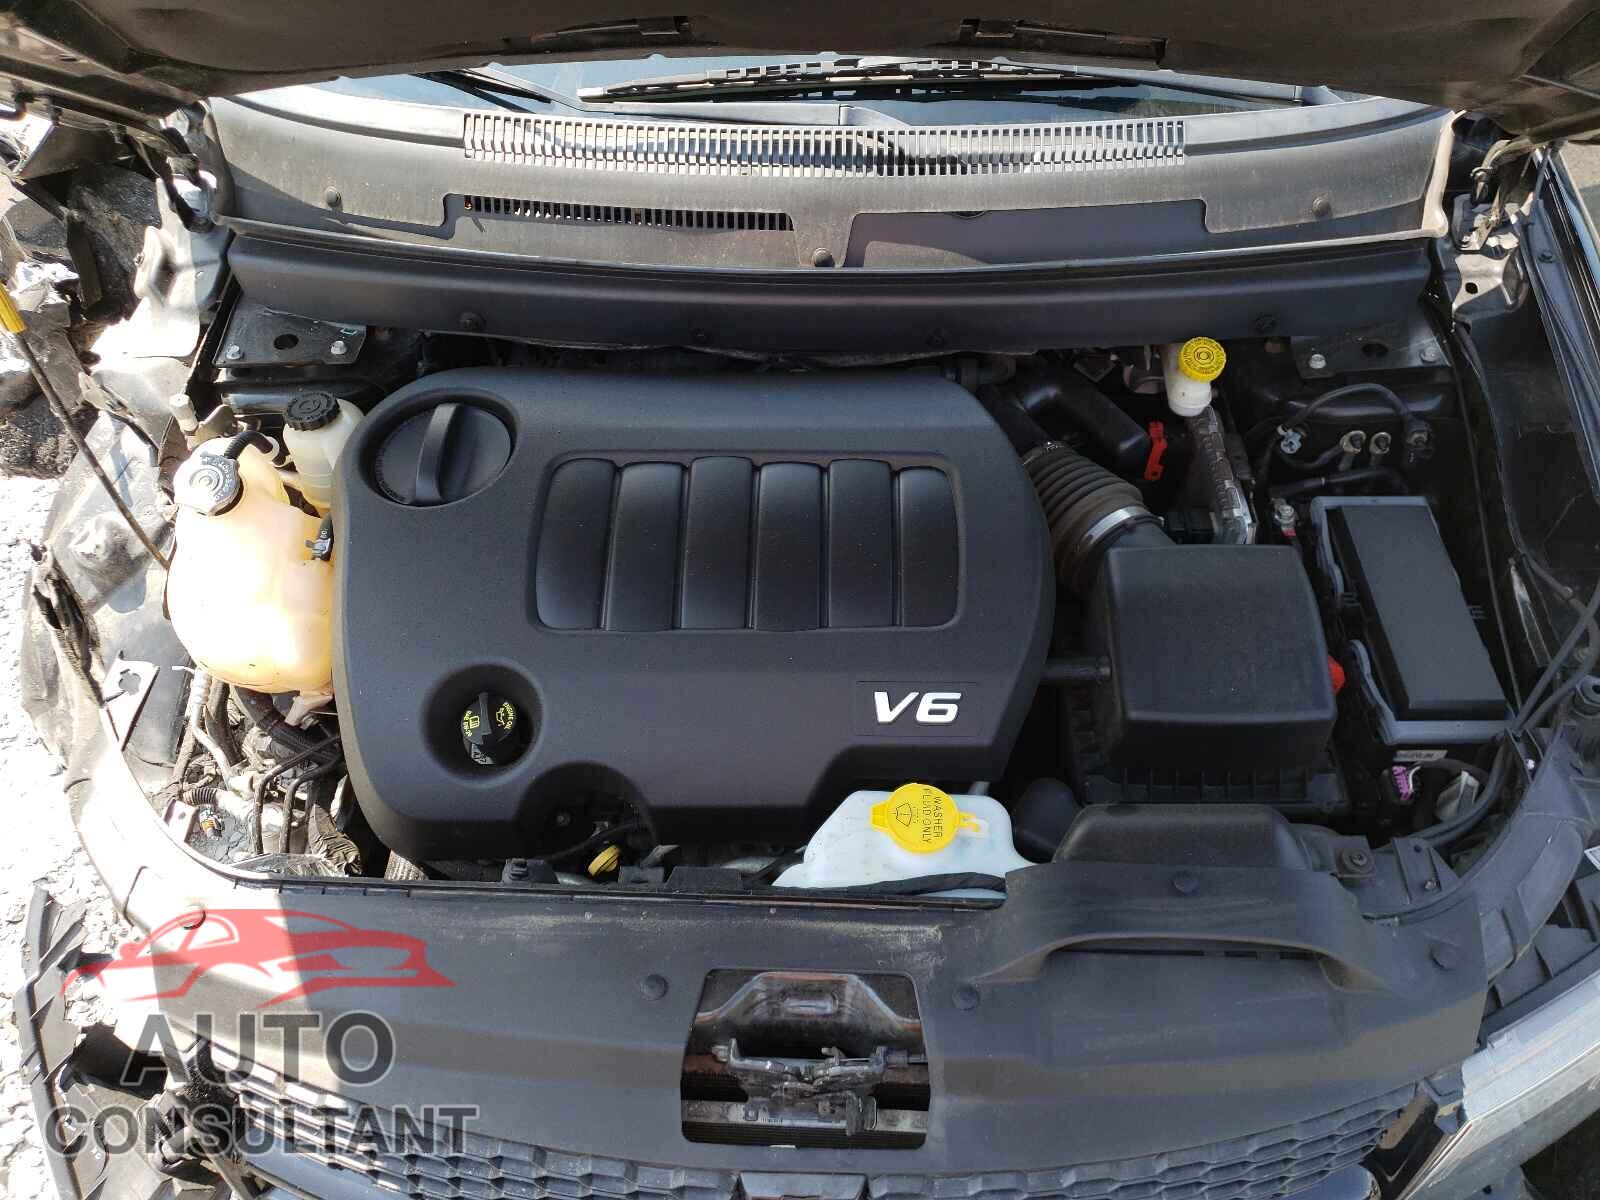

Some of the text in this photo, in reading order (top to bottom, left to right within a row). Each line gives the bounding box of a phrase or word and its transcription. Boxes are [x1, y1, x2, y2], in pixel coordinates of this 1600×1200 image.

[874, 691, 962, 723] V6
[922, 788, 932, 844] FLUID ONLY
[933, 796, 943, 838] WASHER
